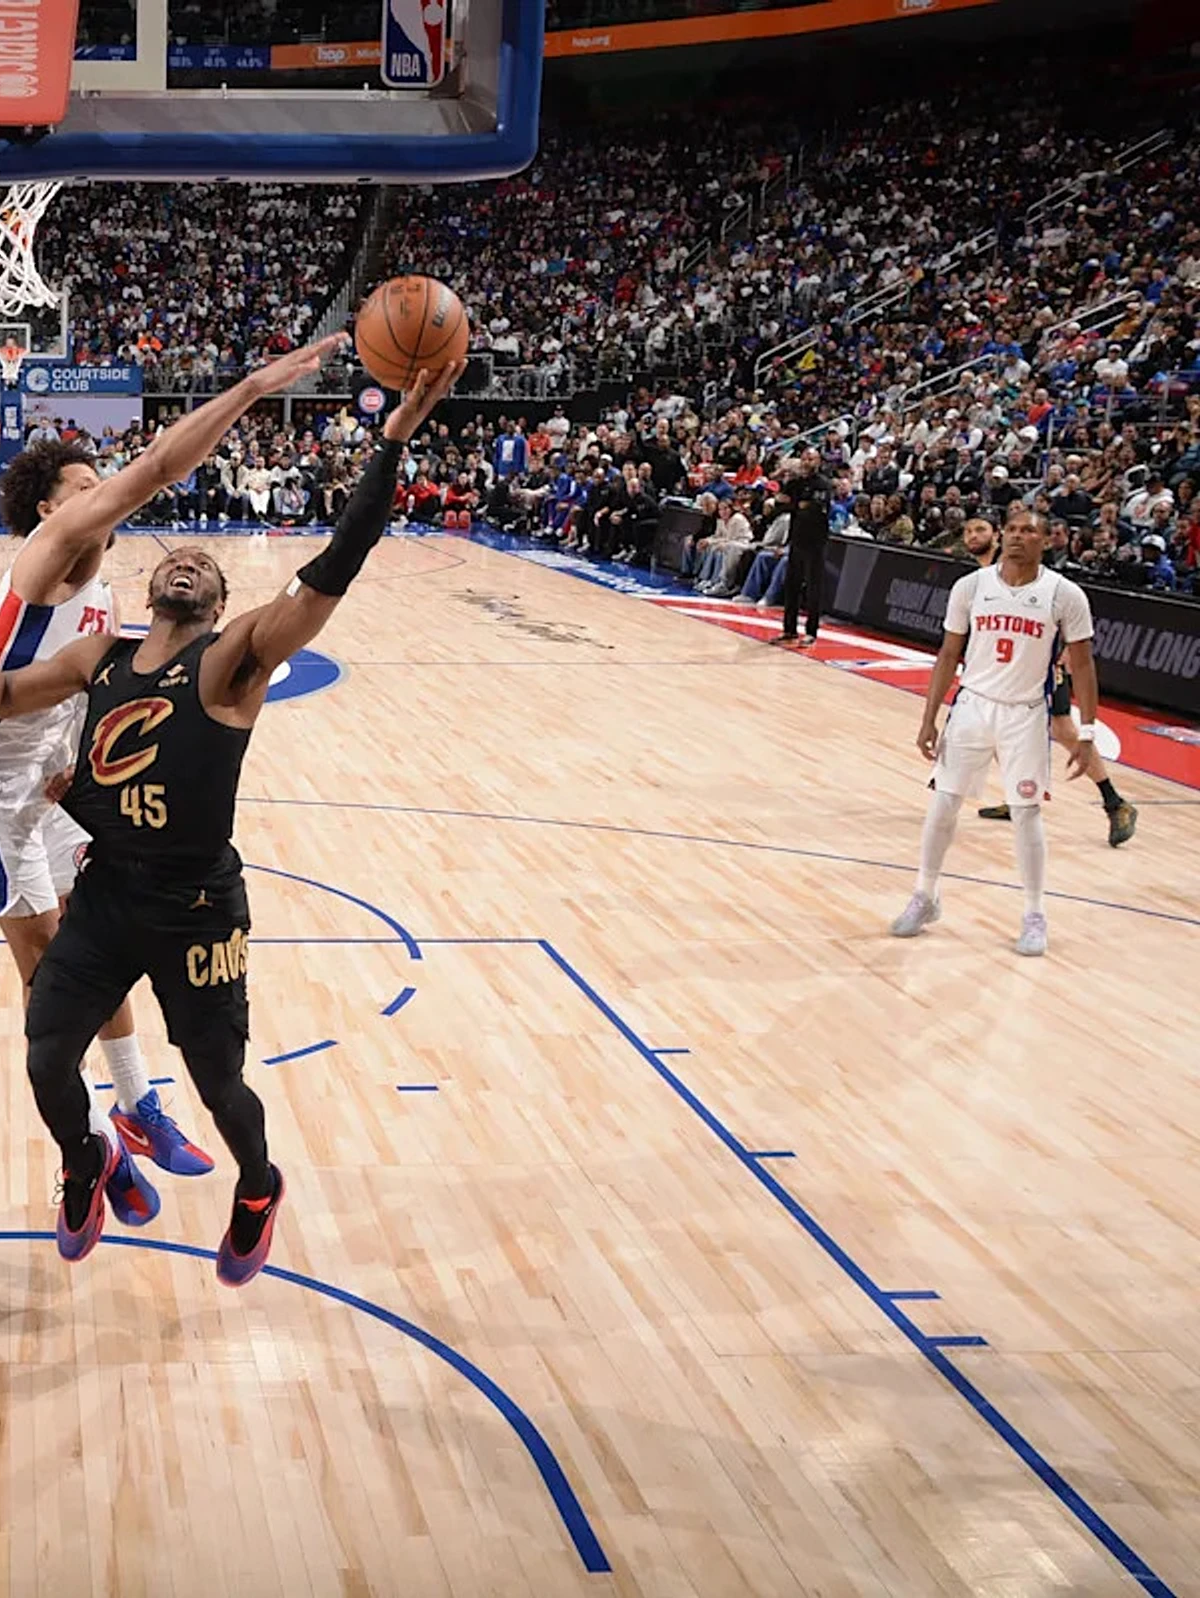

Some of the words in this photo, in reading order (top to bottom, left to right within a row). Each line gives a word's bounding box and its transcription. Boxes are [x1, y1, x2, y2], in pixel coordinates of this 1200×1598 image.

[318, 47, 345, 63] hap
[390, 53, 421, 77] NBA
[52, 368, 130, 380] COURTSIDE
[52, 380, 90, 391] CLUB
[975, 615, 1045, 639] PISTONS
[996, 638, 1014, 663] 9
[1134, 627, 1200, 680] LONG
[88, 696, 174, 786] C
[119, 784, 168, 830] 45
